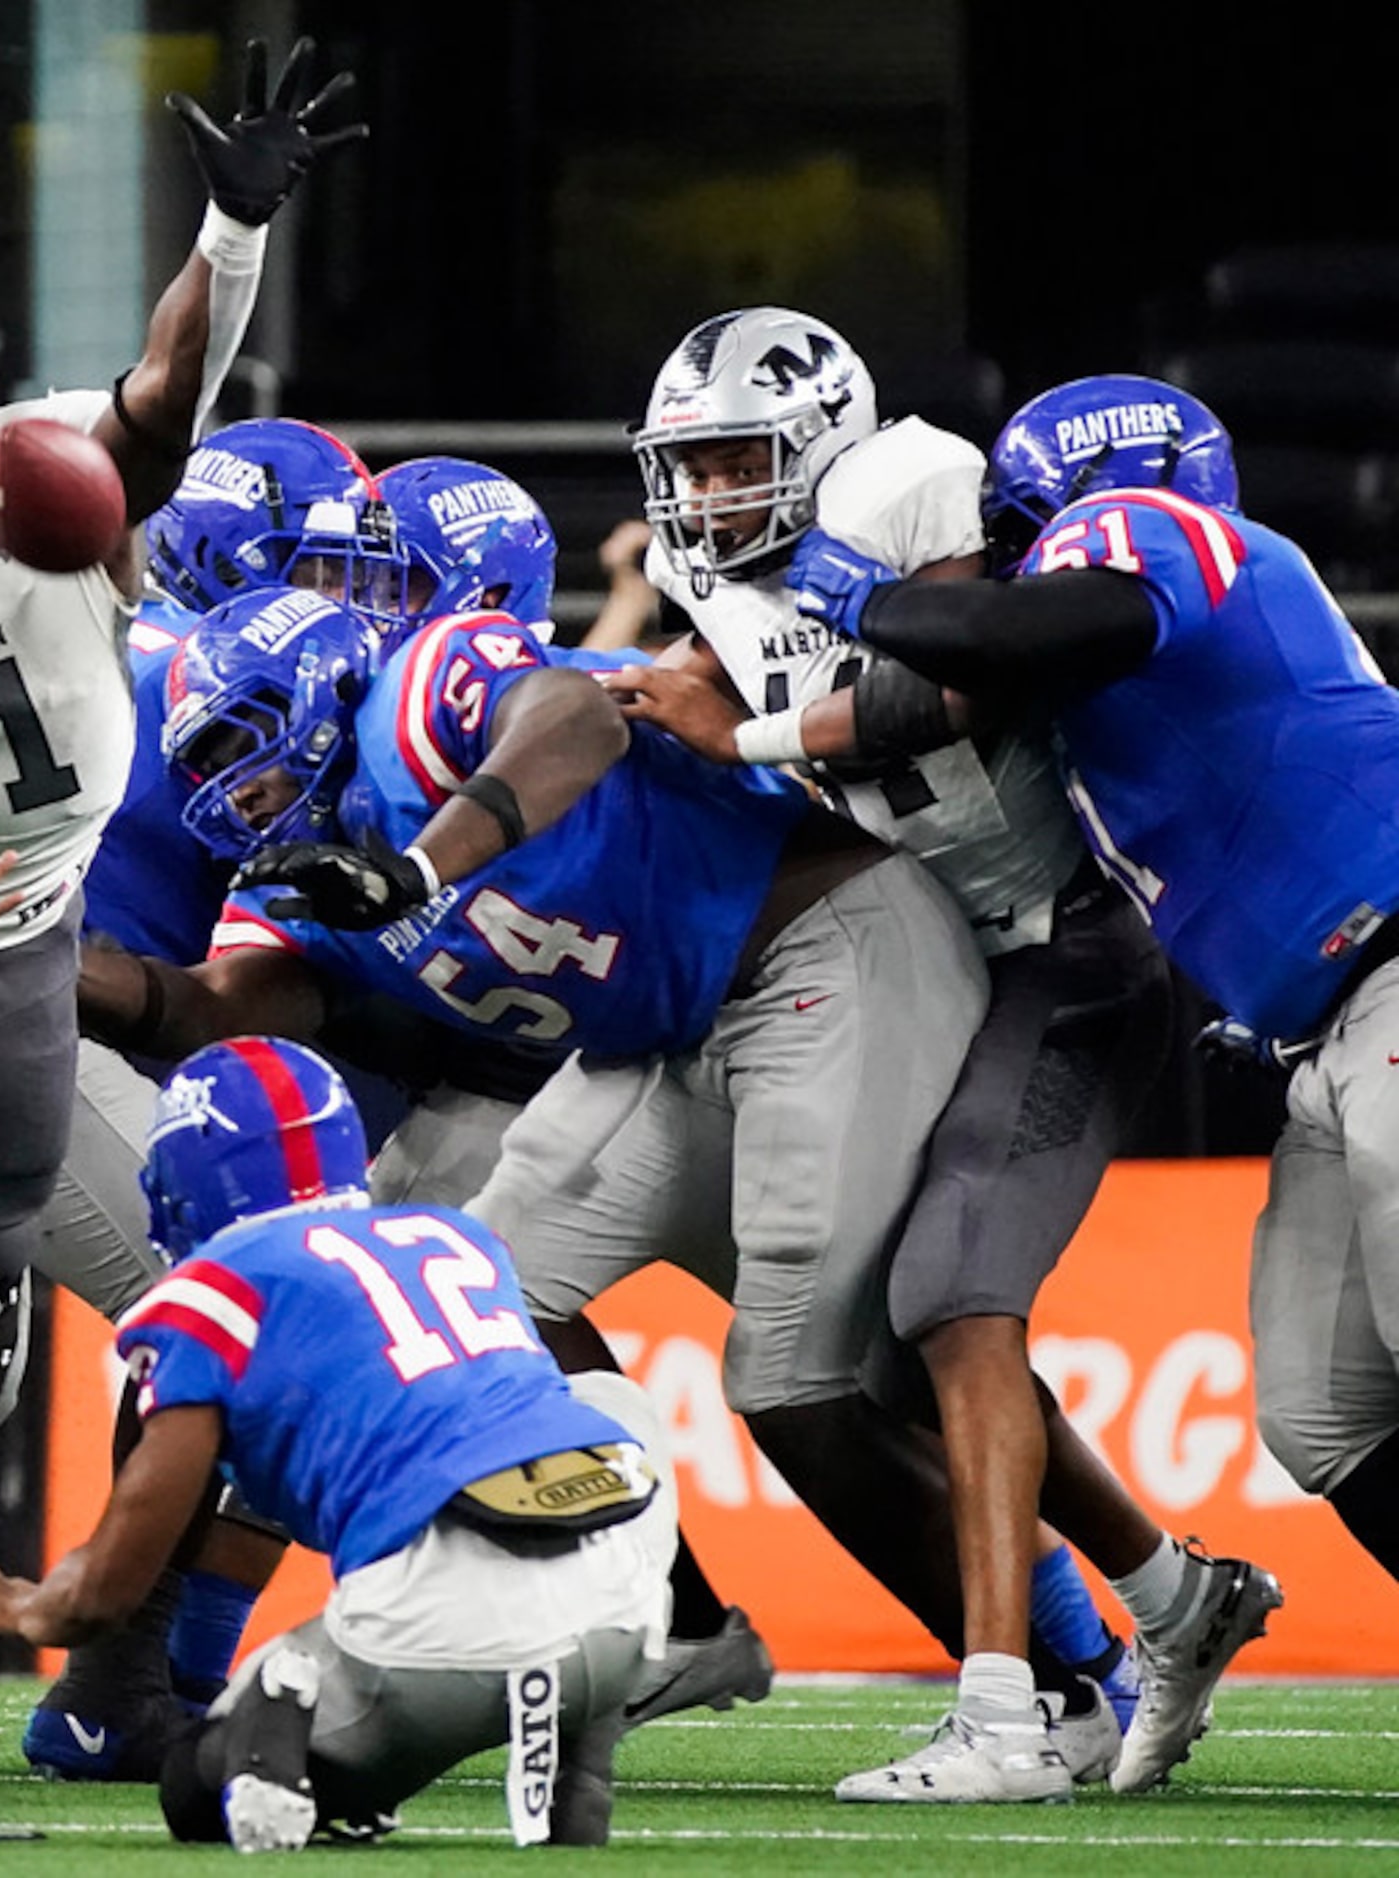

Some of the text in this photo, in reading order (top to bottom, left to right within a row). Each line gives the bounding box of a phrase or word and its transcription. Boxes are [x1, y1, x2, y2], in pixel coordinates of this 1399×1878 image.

[1056, 403, 1184, 455] PANTHERS
[1040, 506, 1144, 574] 51
[440, 631, 538, 735] 54
[417, 885, 622, 1041] 54
[304, 1212, 544, 1387] 12
[520, 1668, 552, 1818] GATO
